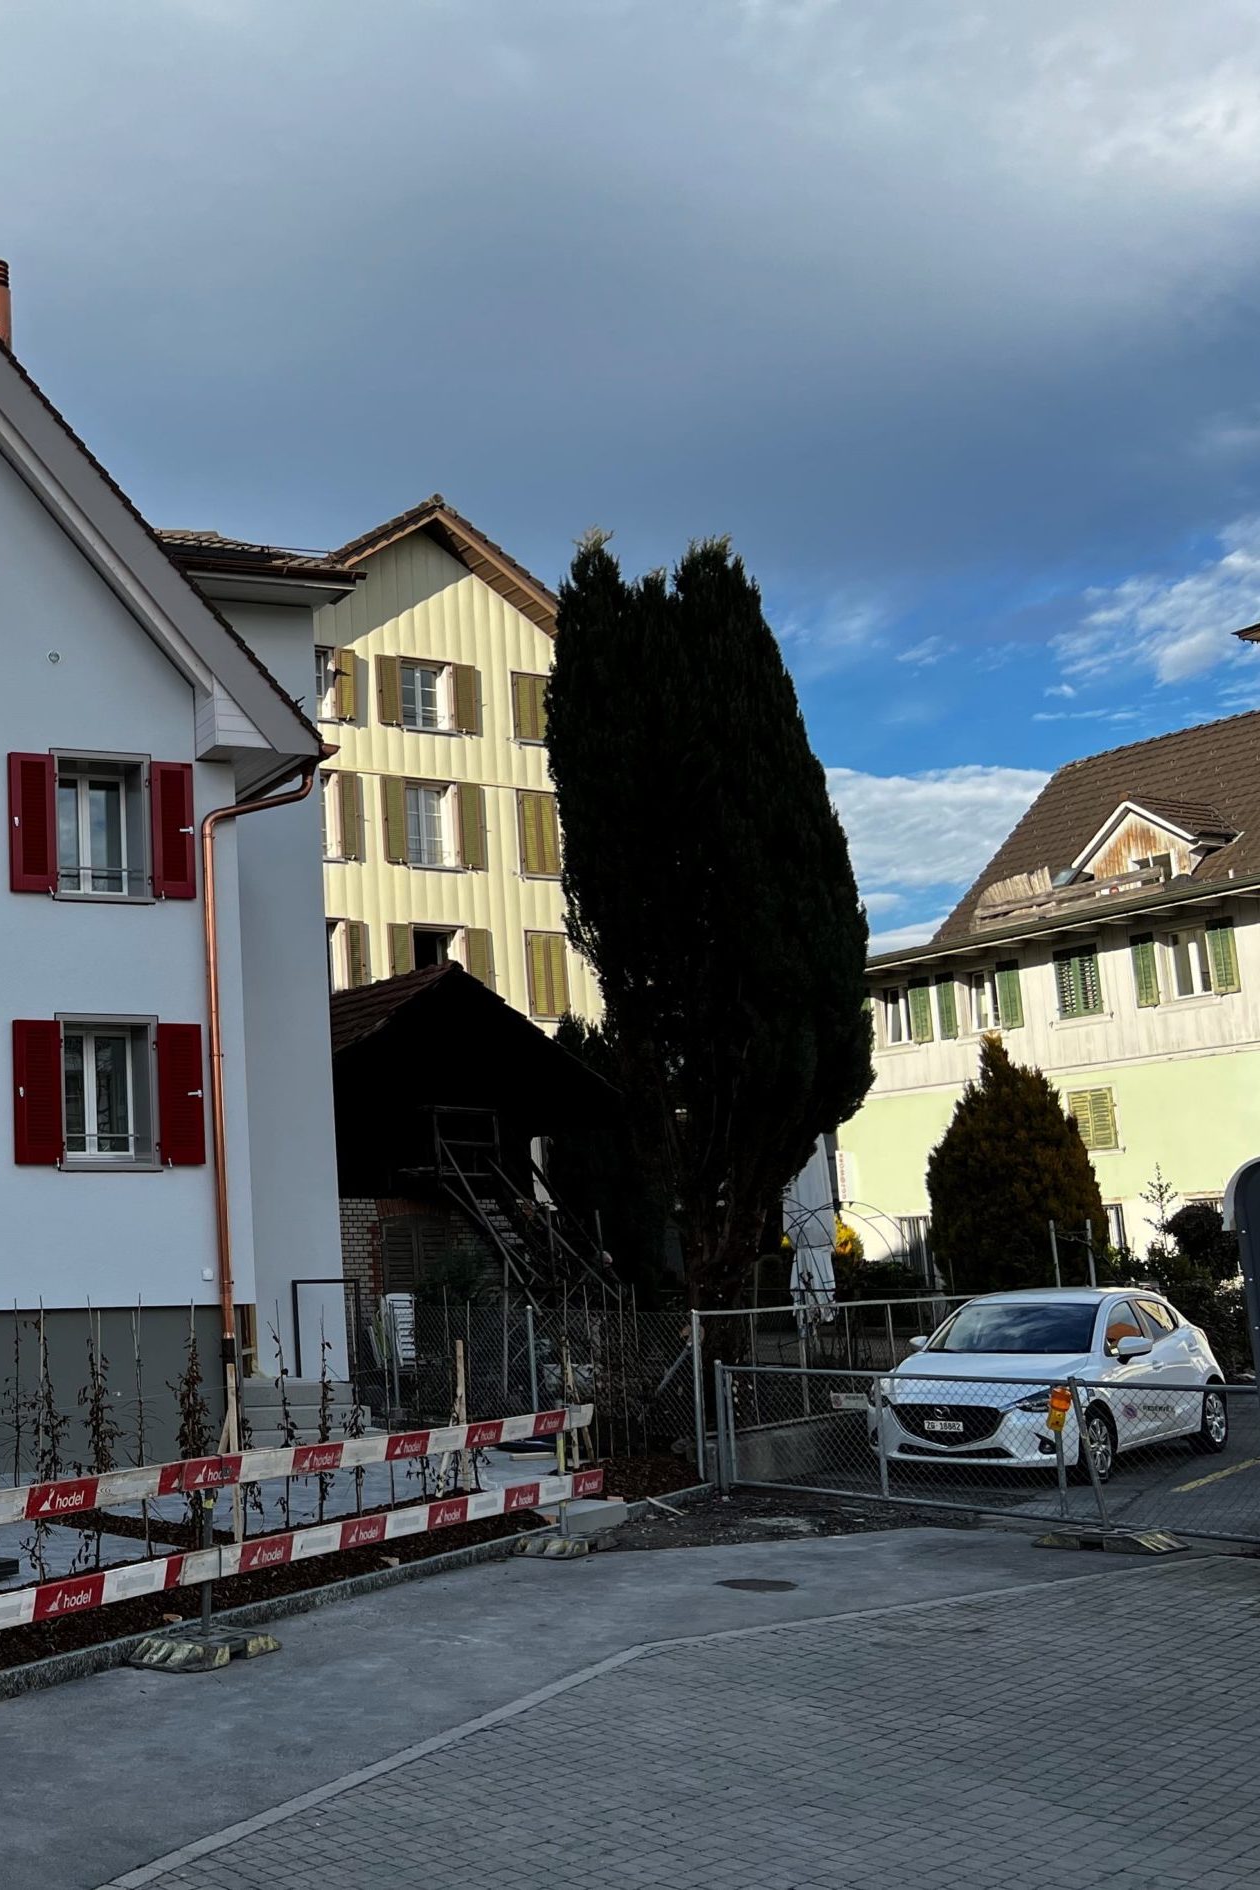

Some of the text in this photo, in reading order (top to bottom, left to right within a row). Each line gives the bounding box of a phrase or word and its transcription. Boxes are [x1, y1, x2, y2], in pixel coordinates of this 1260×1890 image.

[403, 1440, 422, 1453] hodel
[313, 1451, 334, 1466] hodel
[55, 1491, 84, 1509] hodel
[518, 1490, 534, 1505] hodel
[443, 1505, 461, 1521] hodel
[358, 1526, 379, 1541] hodel
[261, 1547, 284, 1563] hodel
[63, 1589, 92, 1608] hodel
